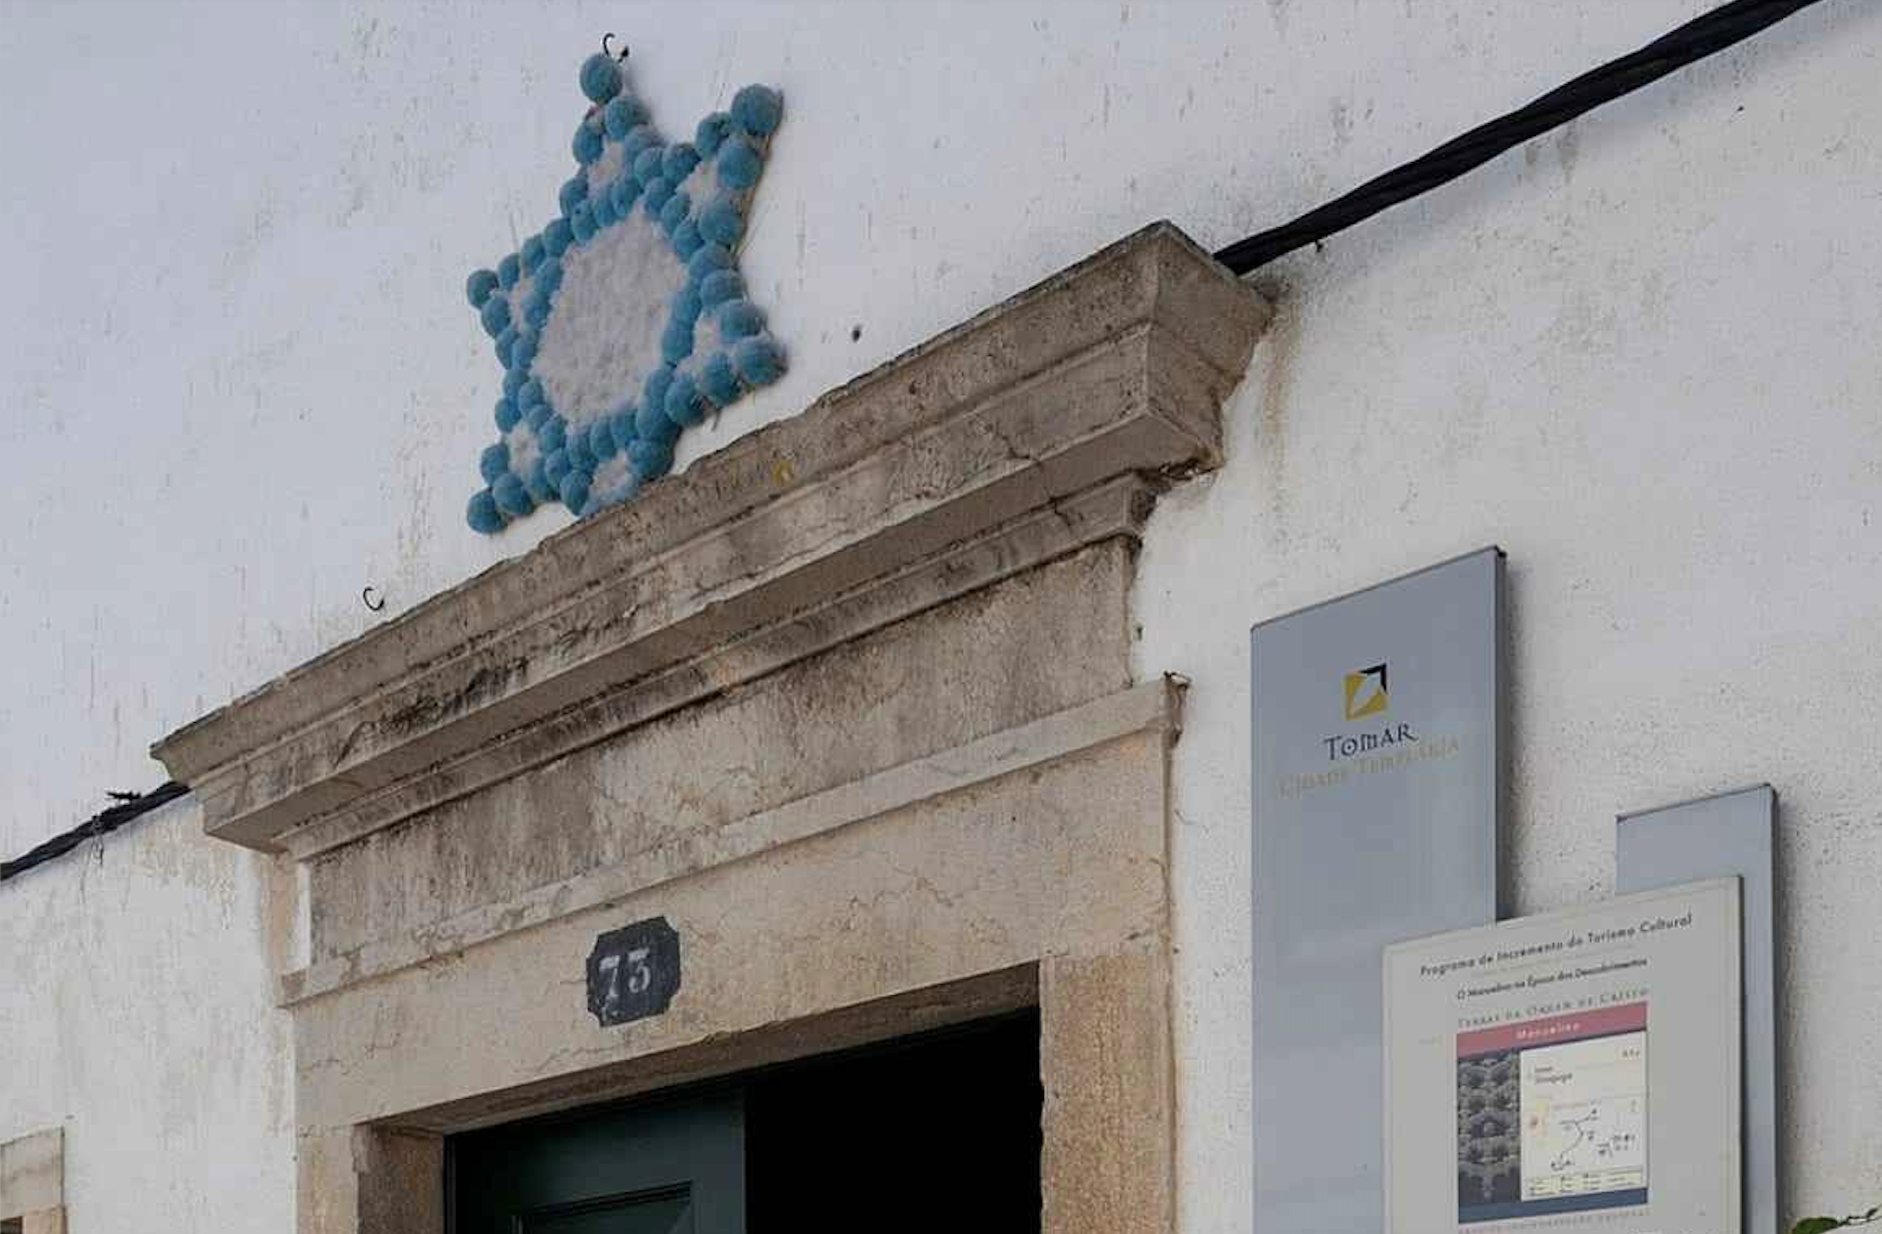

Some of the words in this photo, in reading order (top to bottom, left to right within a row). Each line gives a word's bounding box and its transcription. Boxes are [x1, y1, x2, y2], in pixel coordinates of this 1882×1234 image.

[1323, 723, 1419, 761] TOMAR
[1420, 959, 1475, 977] Programa
[1479, 954, 1493, 966] de
[1497, 941, 1563, 962] Incremento
[1588, 927, 1636, 944] Turismo
[1640, 912, 1692, 932] Cultural
